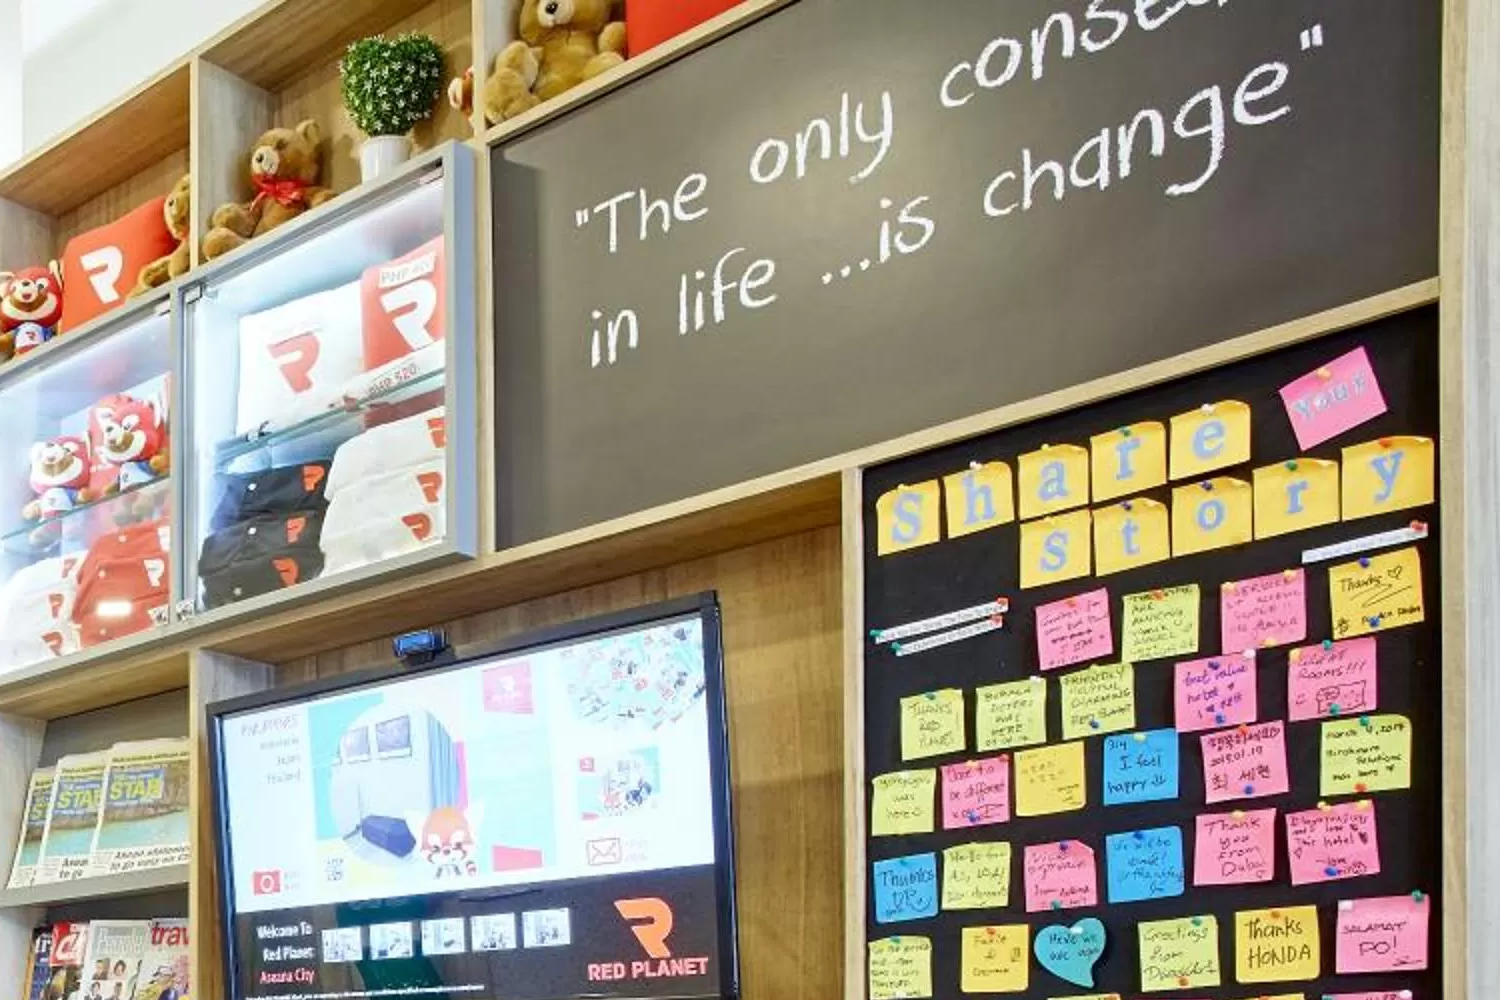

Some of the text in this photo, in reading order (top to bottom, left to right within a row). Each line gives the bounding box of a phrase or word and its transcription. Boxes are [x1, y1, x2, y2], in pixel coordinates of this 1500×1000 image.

[748, 90, 893, 184] only
[588, 304, 639, 368] in
[677, 248, 779, 336] life
[1119, 757, 1132, 770] I
[109, 776, 163, 800] STAR
[1107, 779, 1148, 794] happy
[1204, 816, 1261, 834] Thank
[256, 921, 313, 941] Welcome To
[1143, 926, 1209, 944] Greetings
[1244, 919, 1303, 940] Thanks
[263, 946, 281, 962] Red
[294, 967, 315, 985] City
[587, 957, 709, 981] RED PLANET
